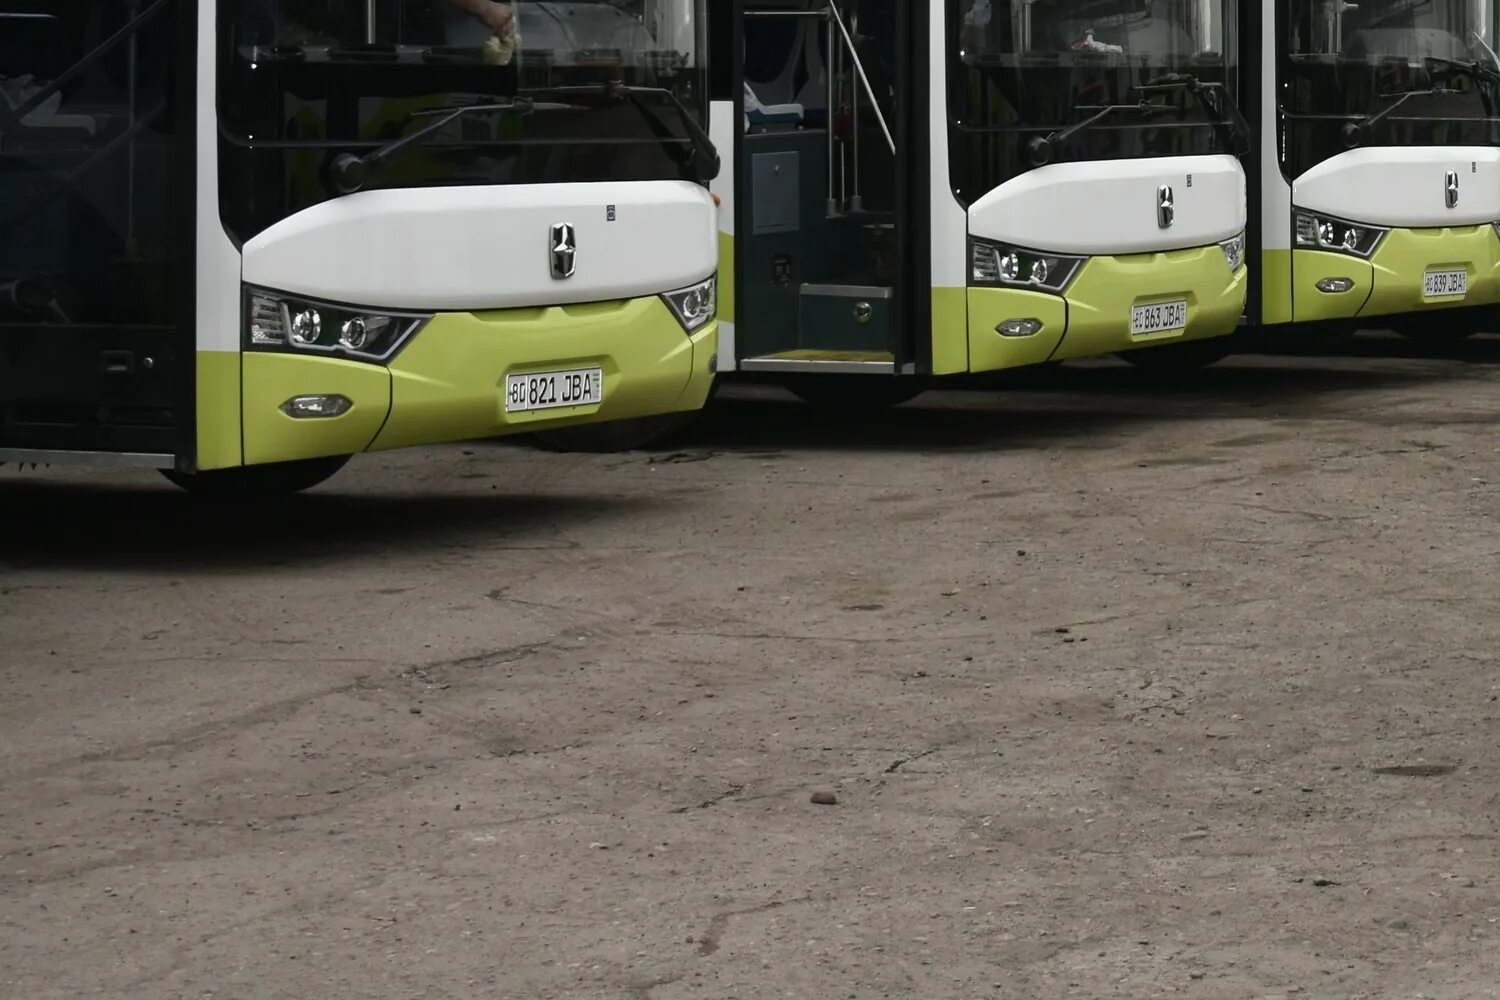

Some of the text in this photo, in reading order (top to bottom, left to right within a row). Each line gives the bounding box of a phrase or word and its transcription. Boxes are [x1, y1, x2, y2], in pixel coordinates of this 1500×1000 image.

[1434, 274, 1447, 292] 839
[1448, 273, 1462, 291] JBA
[1145, 307, 1161, 328] 863
[1163, 304, 1180, 326] JBA
[512, 373, 592, 404] 80 821 JBA
